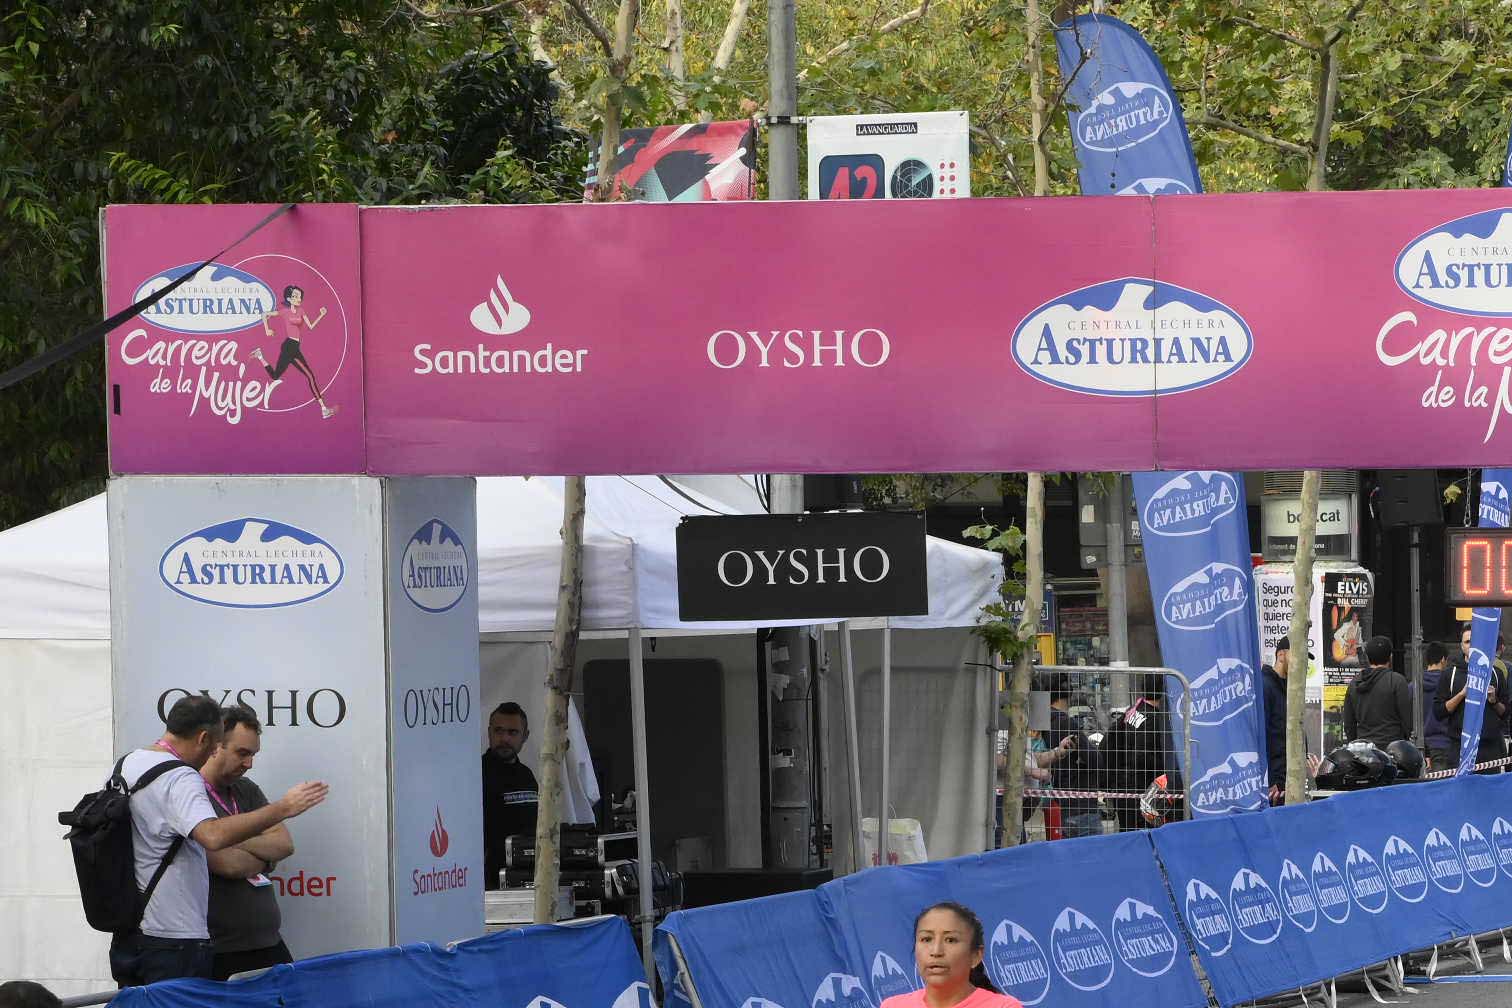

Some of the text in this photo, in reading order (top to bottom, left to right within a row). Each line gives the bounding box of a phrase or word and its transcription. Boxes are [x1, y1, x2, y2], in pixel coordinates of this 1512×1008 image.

[1067, 318, 1226, 331] CENTRAL LECHERA
[120, 328, 239, 366] Carrera
[414, 342, 590, 375] Santander
[706, 328, 891, 369] OYSHO
[1030, 323, 1235, 366] ASTURIANA
[150, 367, 192, 393] de la
[190, 362, 284, 425] Mujer
[1421, 368, 1488, 409] de la
[174, 551, 331, 586] ASTURIANA
[202, 548, 324, 559] CENTRAL LECHERA
[717, 545, 890, 588] OYSHO
[406, 558, 466, 590] ASTURIANA
[1337, 581, 1368, 594] ELVIS
[1263, 599, 1280, 609] que
[404, 684, 471, 729] OYSHO
[412, 862, 469, 897] Santander
